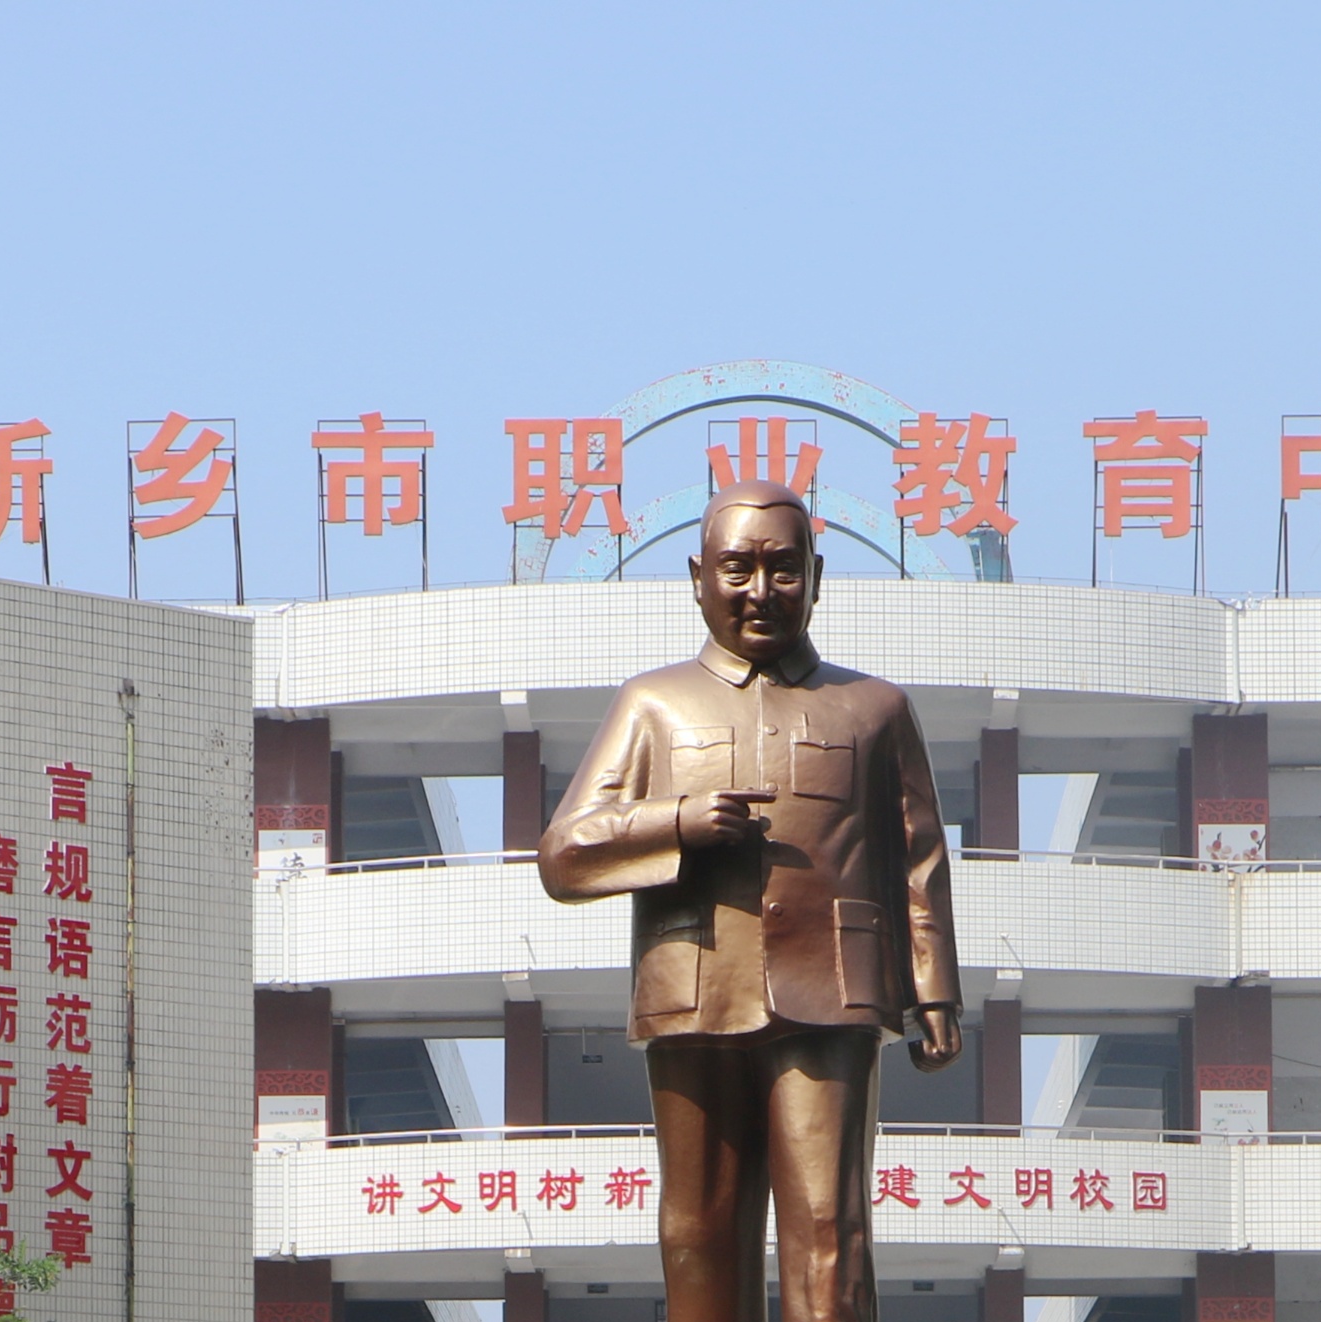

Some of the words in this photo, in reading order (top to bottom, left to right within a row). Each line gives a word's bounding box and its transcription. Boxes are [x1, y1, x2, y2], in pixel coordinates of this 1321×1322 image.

[44, 762, 93, 1269] 言规语范着文章
[872, 1164, 1168, 1212] 建文明校园
